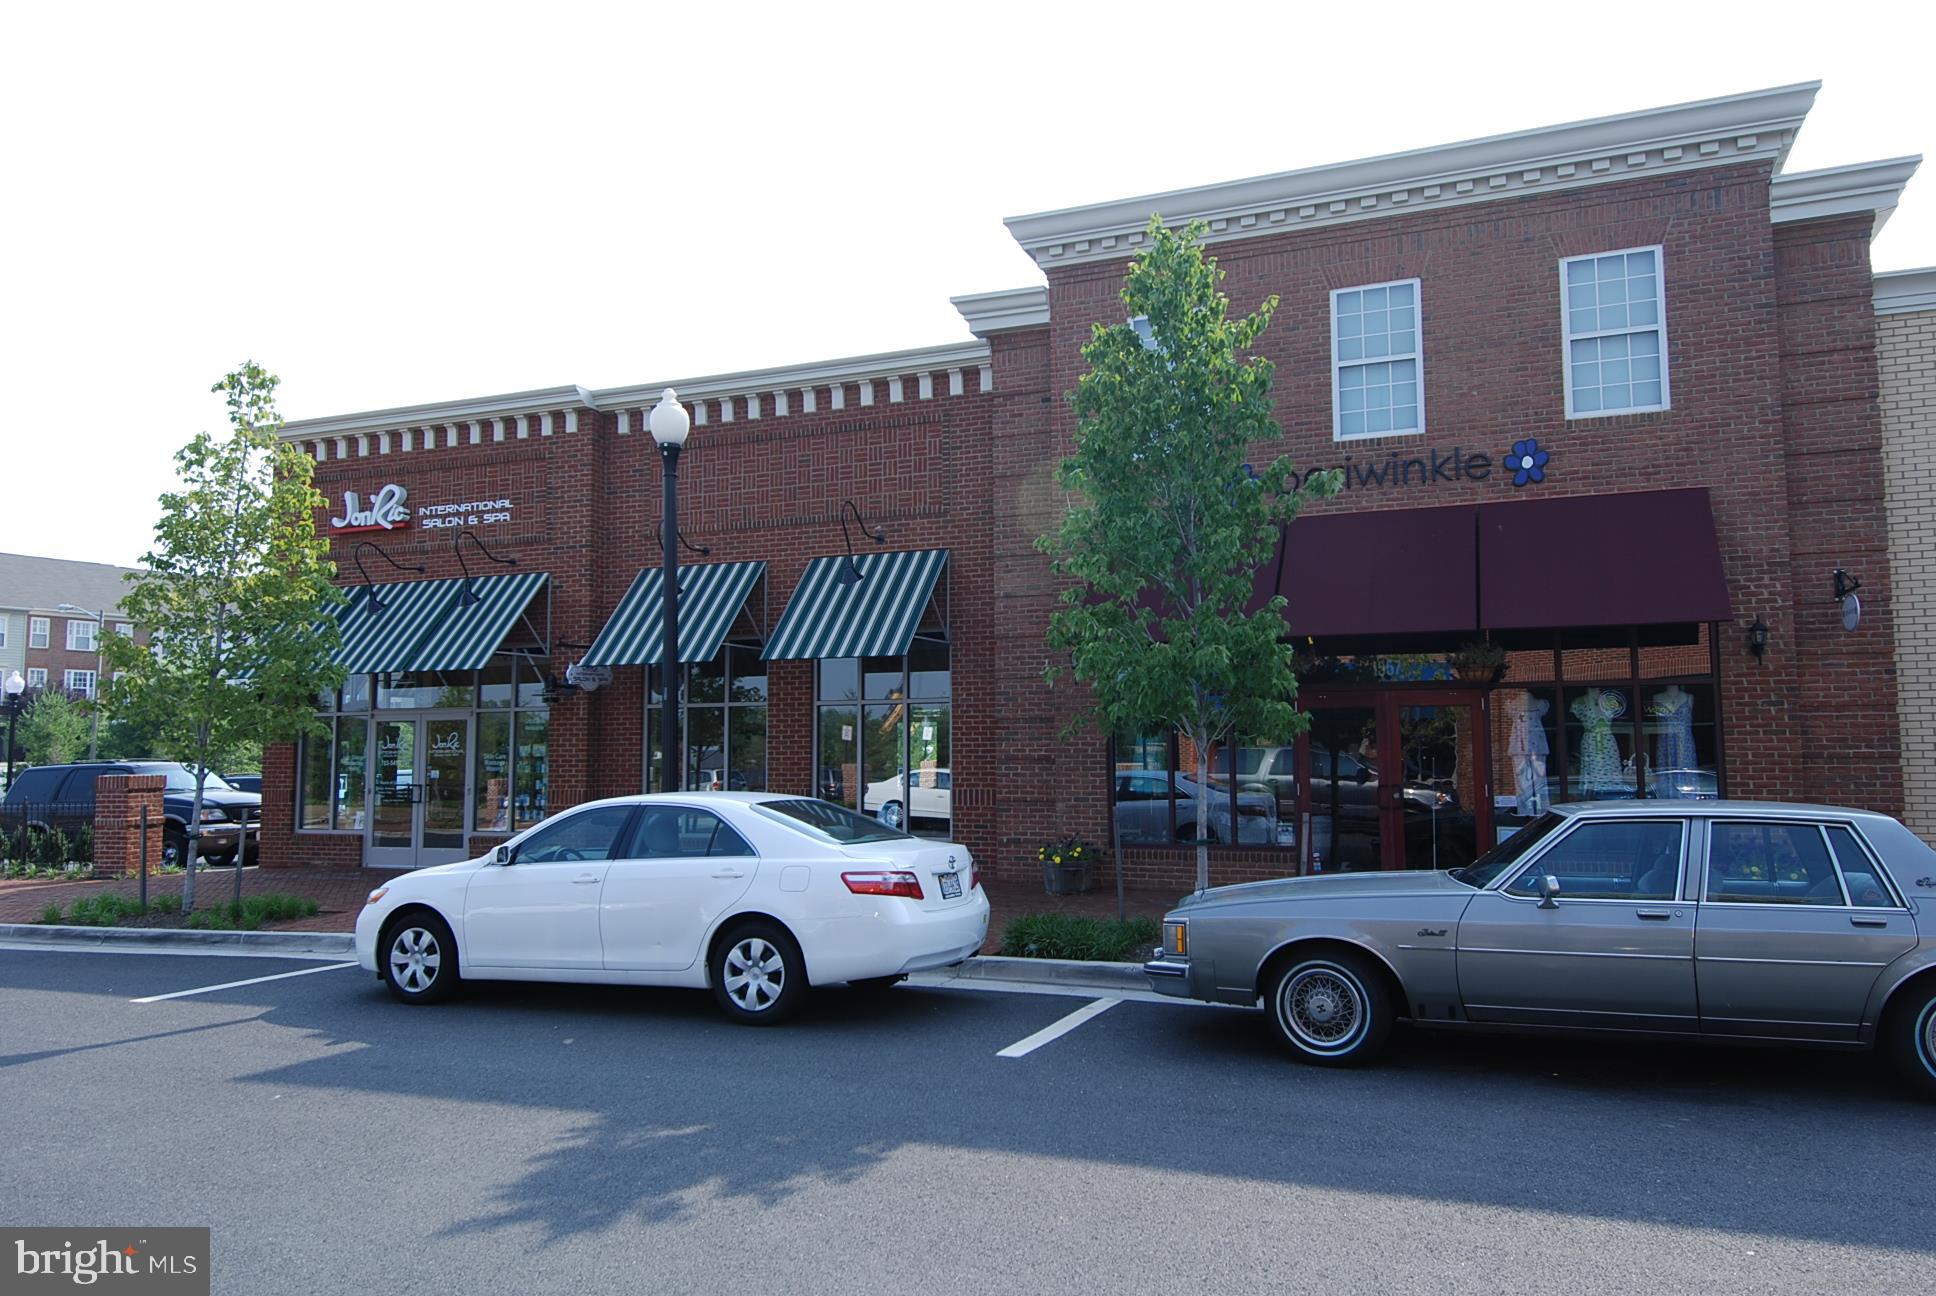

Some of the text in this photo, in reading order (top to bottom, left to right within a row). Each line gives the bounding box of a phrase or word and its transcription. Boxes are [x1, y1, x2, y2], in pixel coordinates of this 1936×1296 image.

[419, 499, 514, 516] INTERNATIONAL
[422, 512, 510, 529] SALON & SPA
